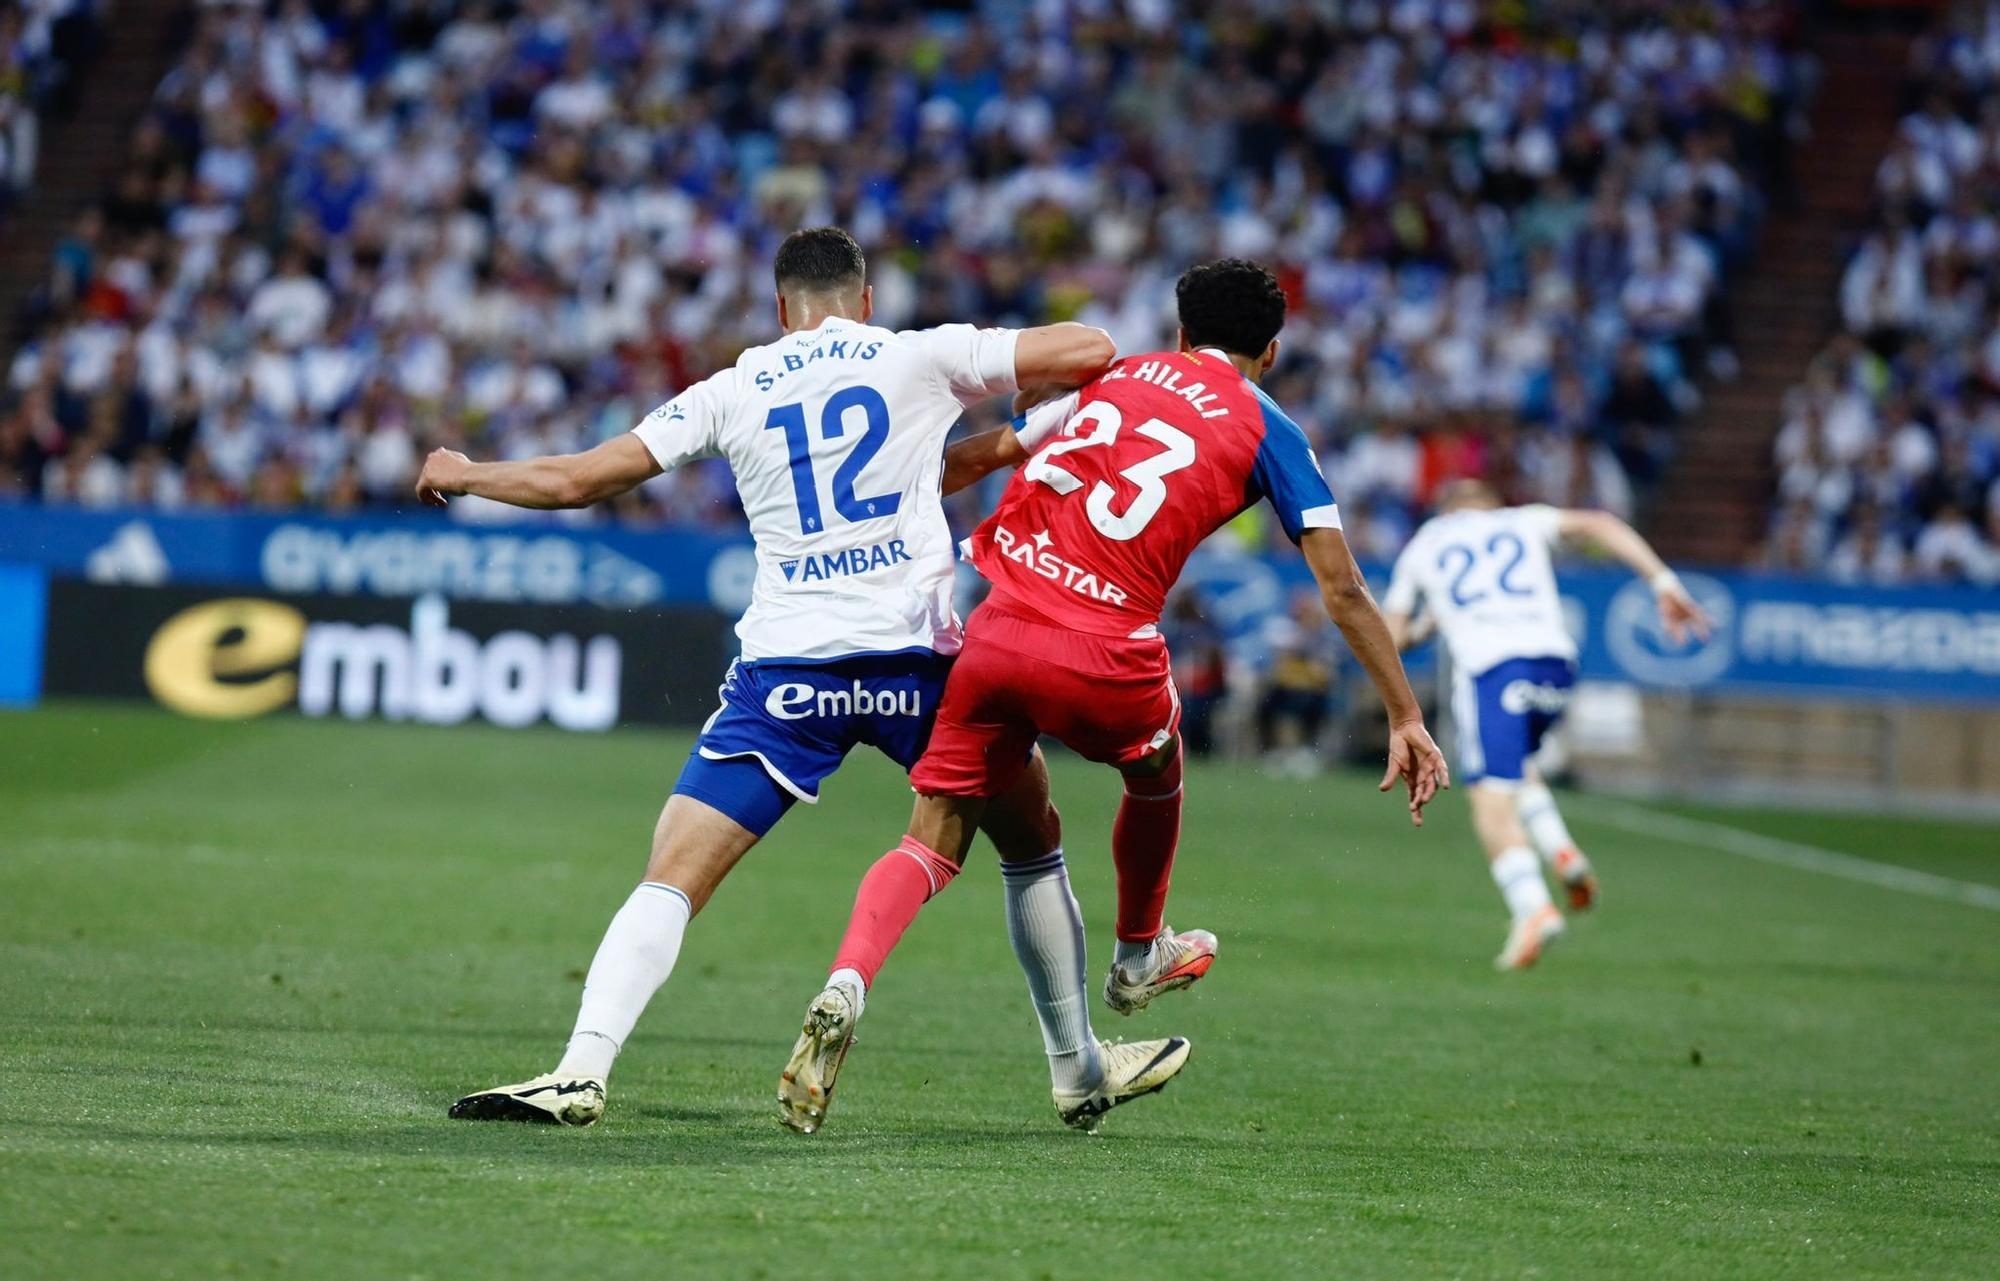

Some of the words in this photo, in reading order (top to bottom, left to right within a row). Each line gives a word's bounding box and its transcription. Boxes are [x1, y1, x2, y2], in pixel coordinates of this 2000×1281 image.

[755, 340, 884, 392] S.BAKIS
[1132, 360, 1230, 419] HILALI
[764, 385, 903, 536] 12
[1023, 400, 1196, 542] 23
[262, 524, 582, 601] avanza
[801, 538, 912, 582] AMBAR
[993, 524, 1128, 607] RASTAR
[1437, 531, 1534, 607] 22
[144, 594, 622, 732] embou
[765, 679, 920, 721] embou
